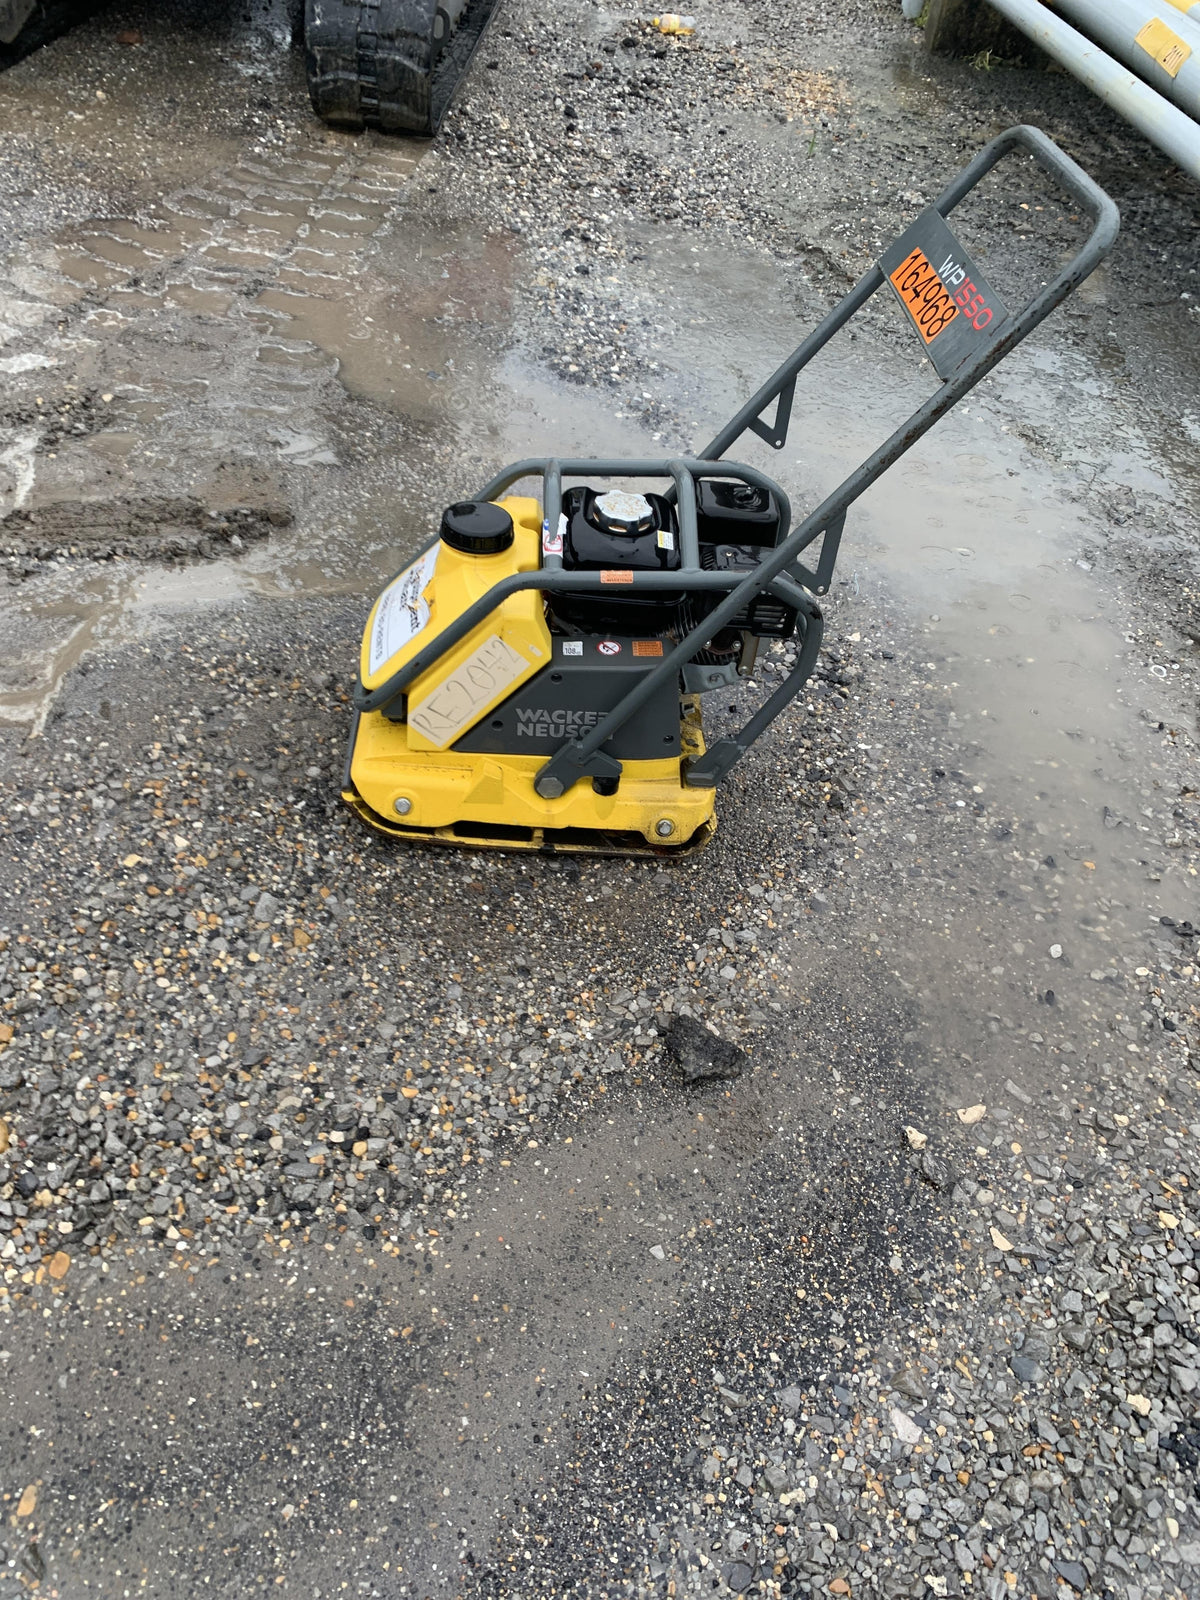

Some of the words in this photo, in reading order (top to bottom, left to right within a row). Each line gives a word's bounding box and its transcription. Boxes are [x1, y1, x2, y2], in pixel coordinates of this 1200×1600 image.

[895, 252, 957, 338] 164968
[938, 253, 993, 331] WP1550
[412, 639, 523, 740] RE2042
